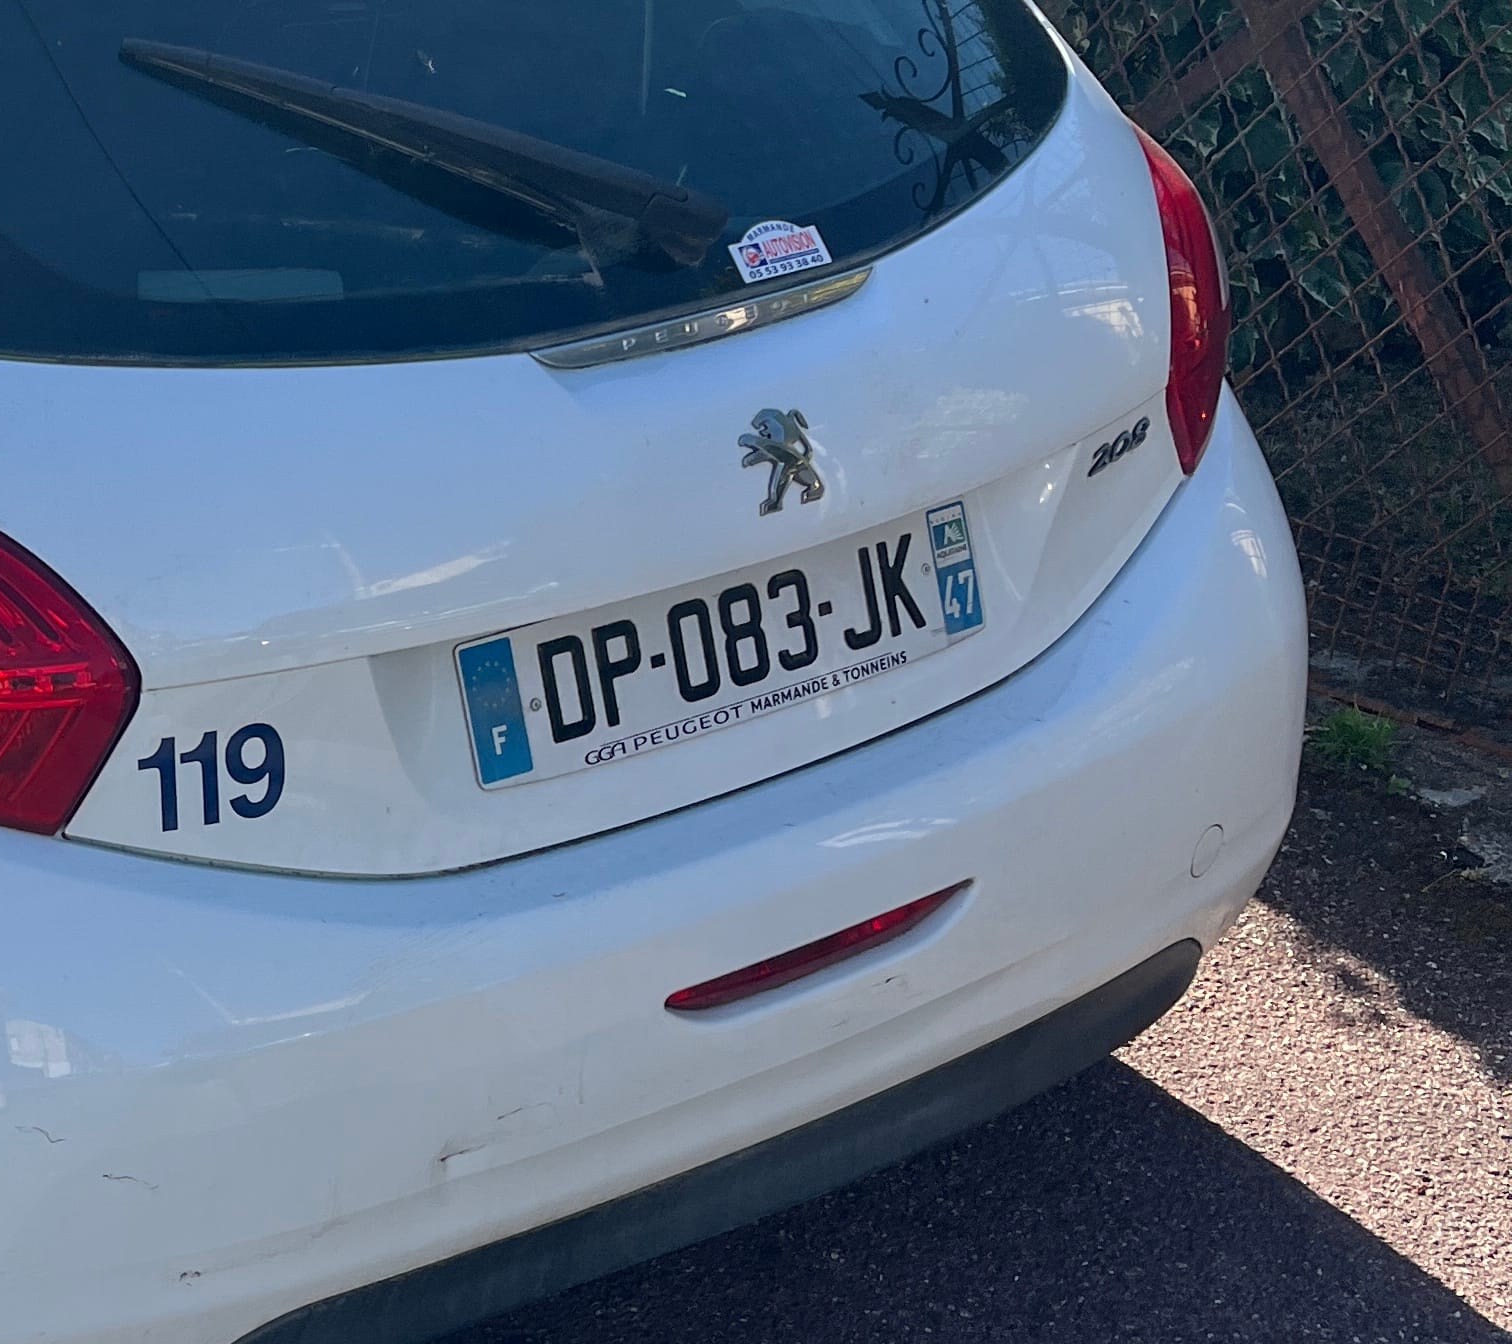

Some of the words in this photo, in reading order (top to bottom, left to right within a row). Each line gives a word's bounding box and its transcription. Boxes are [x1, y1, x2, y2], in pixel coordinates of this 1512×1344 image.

[746, 223, 795, 242] MARMANDE
[761, 231, 816, 258] AUTOVISION
[749, 269, 763, 279] 05
[764, 265, 779, 276] 53
[779, 261, 794, 272] 93
[796, 257, 809, 268] 38
[810, 254, 824, 264] 40
[1087, 416, 1150, 477] 208
[944, 568, 975, 619] 47
[537, 533, 927, 744] DP-083-JK
[634, 704, 743, 751] PEUGEOT
[750, 677, 829, 714] MARMANDE
[831, 673, 841, 687] &
[843, 650, 907, 683] TONNEINS
[491, 724, 508, 756] F
[137, 722, 286, 833] 119
